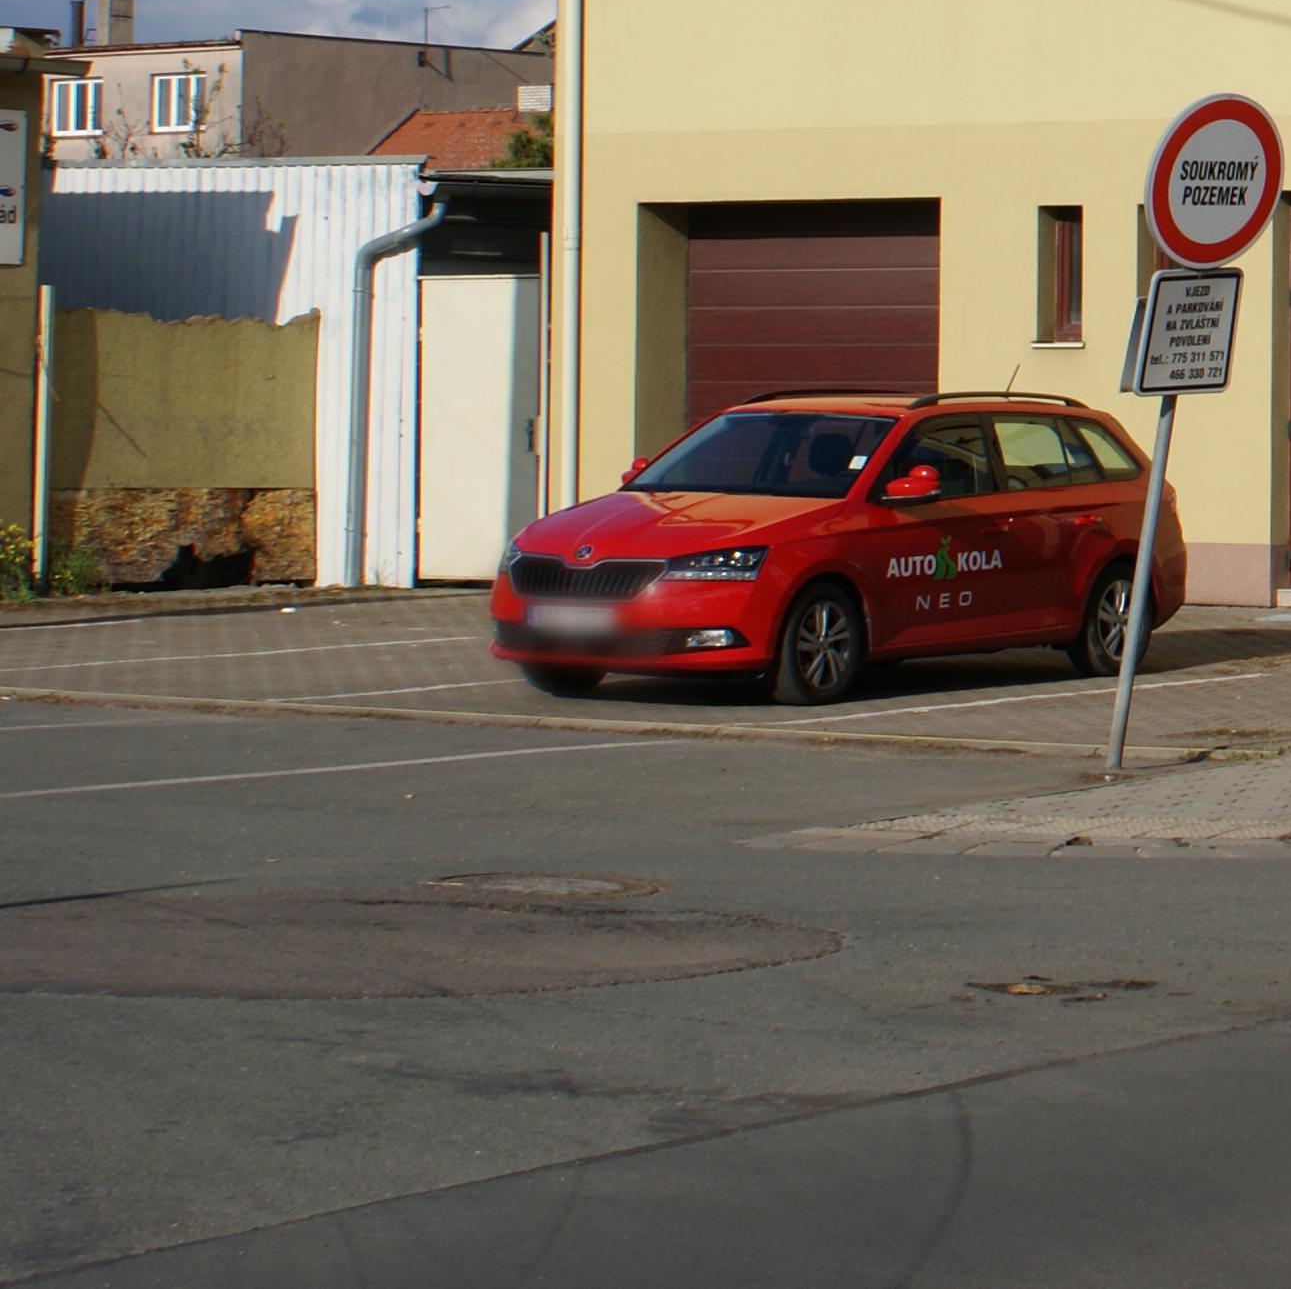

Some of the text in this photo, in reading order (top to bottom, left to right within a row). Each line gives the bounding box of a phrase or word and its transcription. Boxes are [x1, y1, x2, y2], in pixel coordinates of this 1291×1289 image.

[1180, 156, 1259, 181] SOUKROMÝ
[1182, 186, 1249, 206] POZEMEK
[1185, 285, 1211, 297] VJEZD
[1166, 298, 1225, 315] A PARKOVÁNÍ
[1165, 314, 1220, 331] NA ZVLÁŠTNÍ
[1169, 332, 1213, 348] POVOLENÍ
[1171, 353, 1188, 364] 775
[1190, 351, 1206, 363] 311
[1209, 350, 1225, 362] 571
[1207, 367, 1223, 378] 721
[916, 591, 972, 610] NEO
